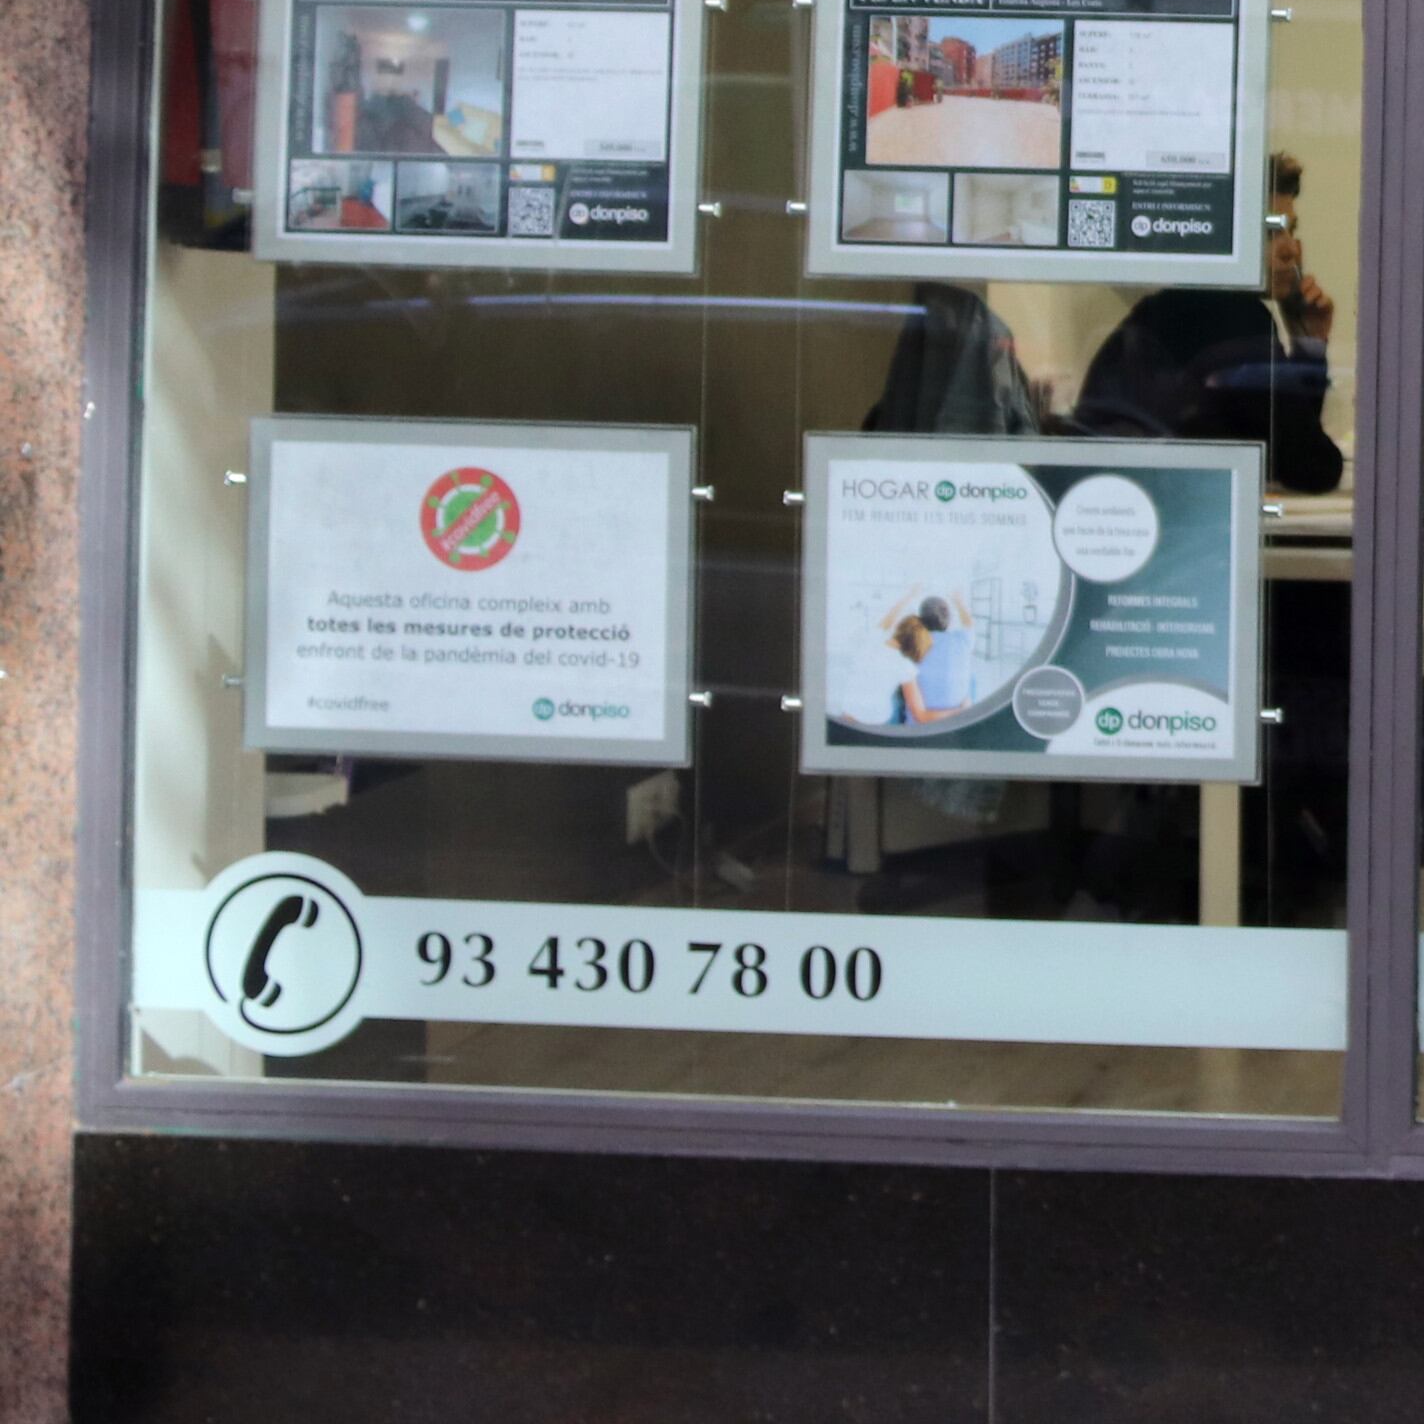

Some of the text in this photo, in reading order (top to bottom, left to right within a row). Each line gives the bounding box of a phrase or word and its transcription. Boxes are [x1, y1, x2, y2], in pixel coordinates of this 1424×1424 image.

[589, 203, 650, 224] donpiso
[1153, 216, 1213, 238] donpiso
[842, 479, 929, 501] HOGAR
[960, 483, 1028, 504] donpiso
[327, 590, 611, 617] Aquesta oficina compleix amb
[307, 616, 631, 645] totes les mesures de protecció
[297, 642, 640, 669] enfront de la pandèmia del covid-19
[307, 694, 390, 712] #covidfree
[558, 699, 630, 720] donpiso
[1128, 707, 1217, 736] donpiso
[417, 930, 883, 1002] 93 430 78 00
